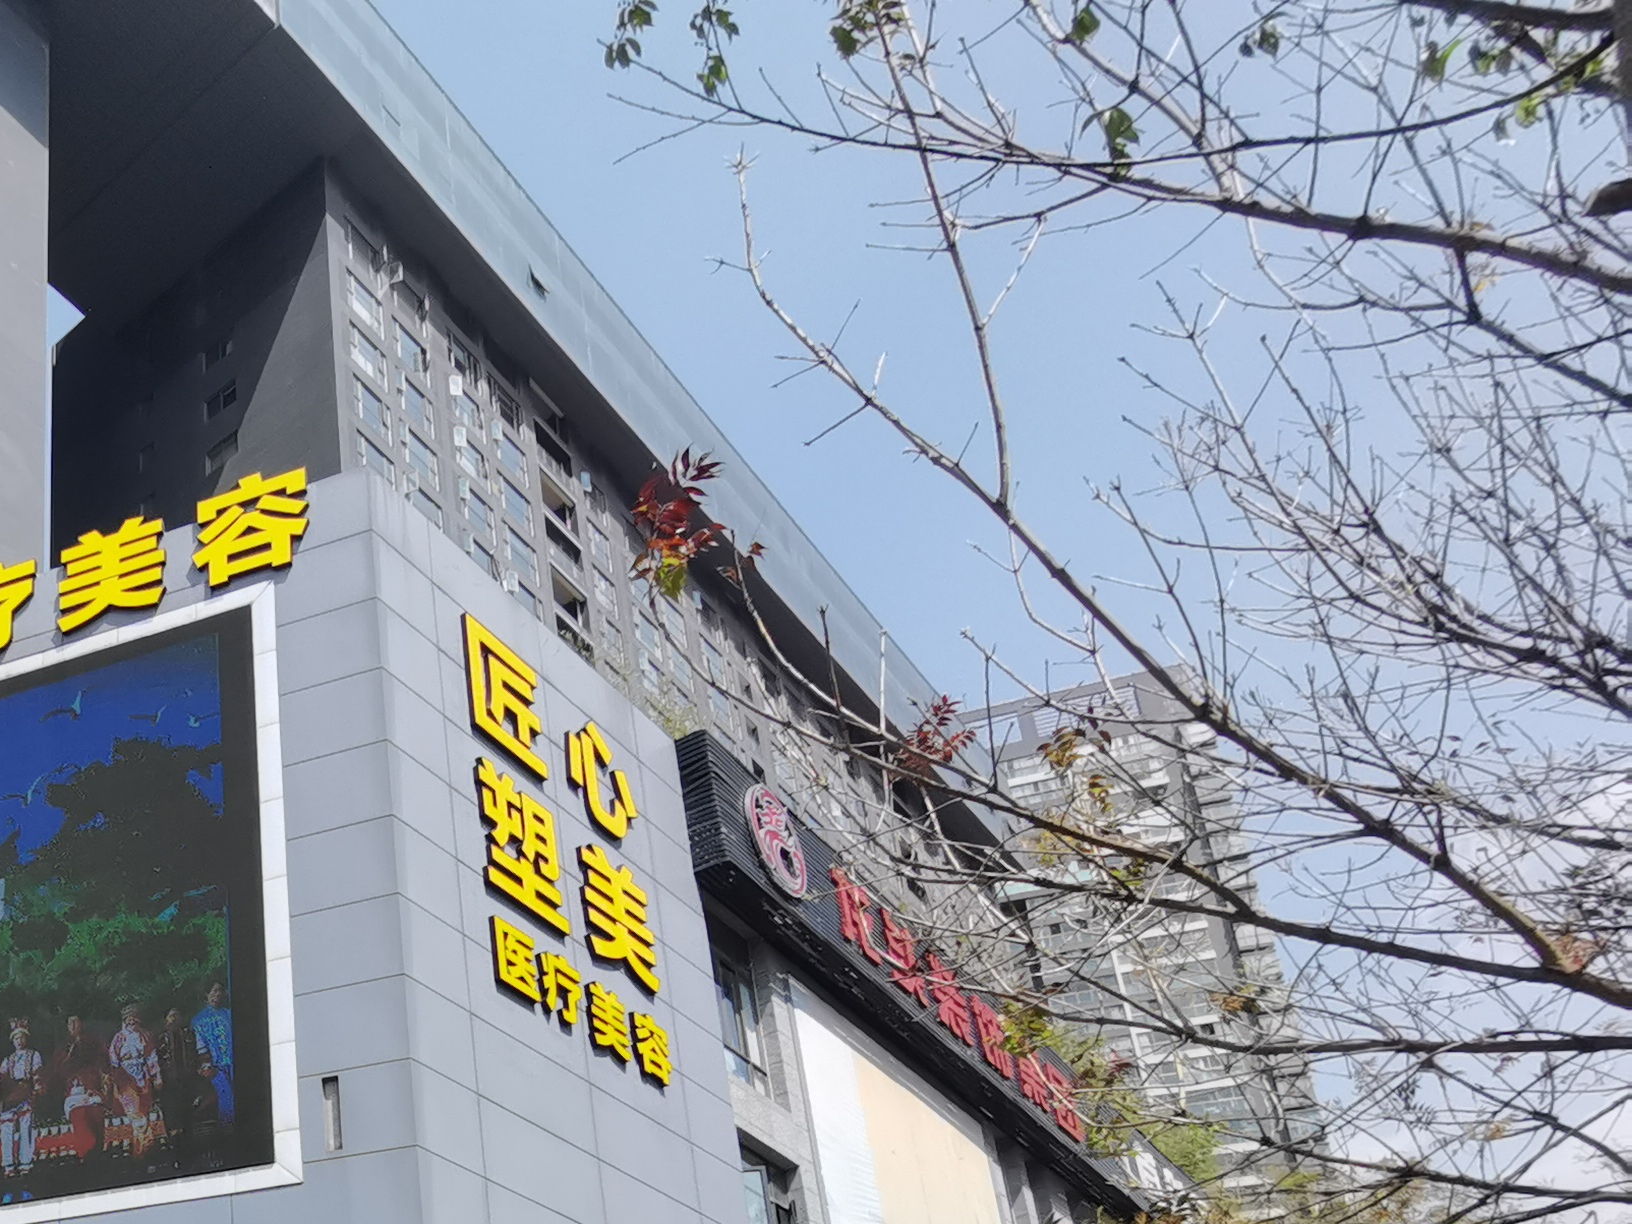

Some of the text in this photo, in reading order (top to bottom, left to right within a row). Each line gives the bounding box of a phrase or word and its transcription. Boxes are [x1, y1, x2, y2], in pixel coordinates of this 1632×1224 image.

[461, 612, 639, 840] 匠心
[474, 755, 662, 996] 塑美
[489, 914, 674, 1089] 医疗美容
